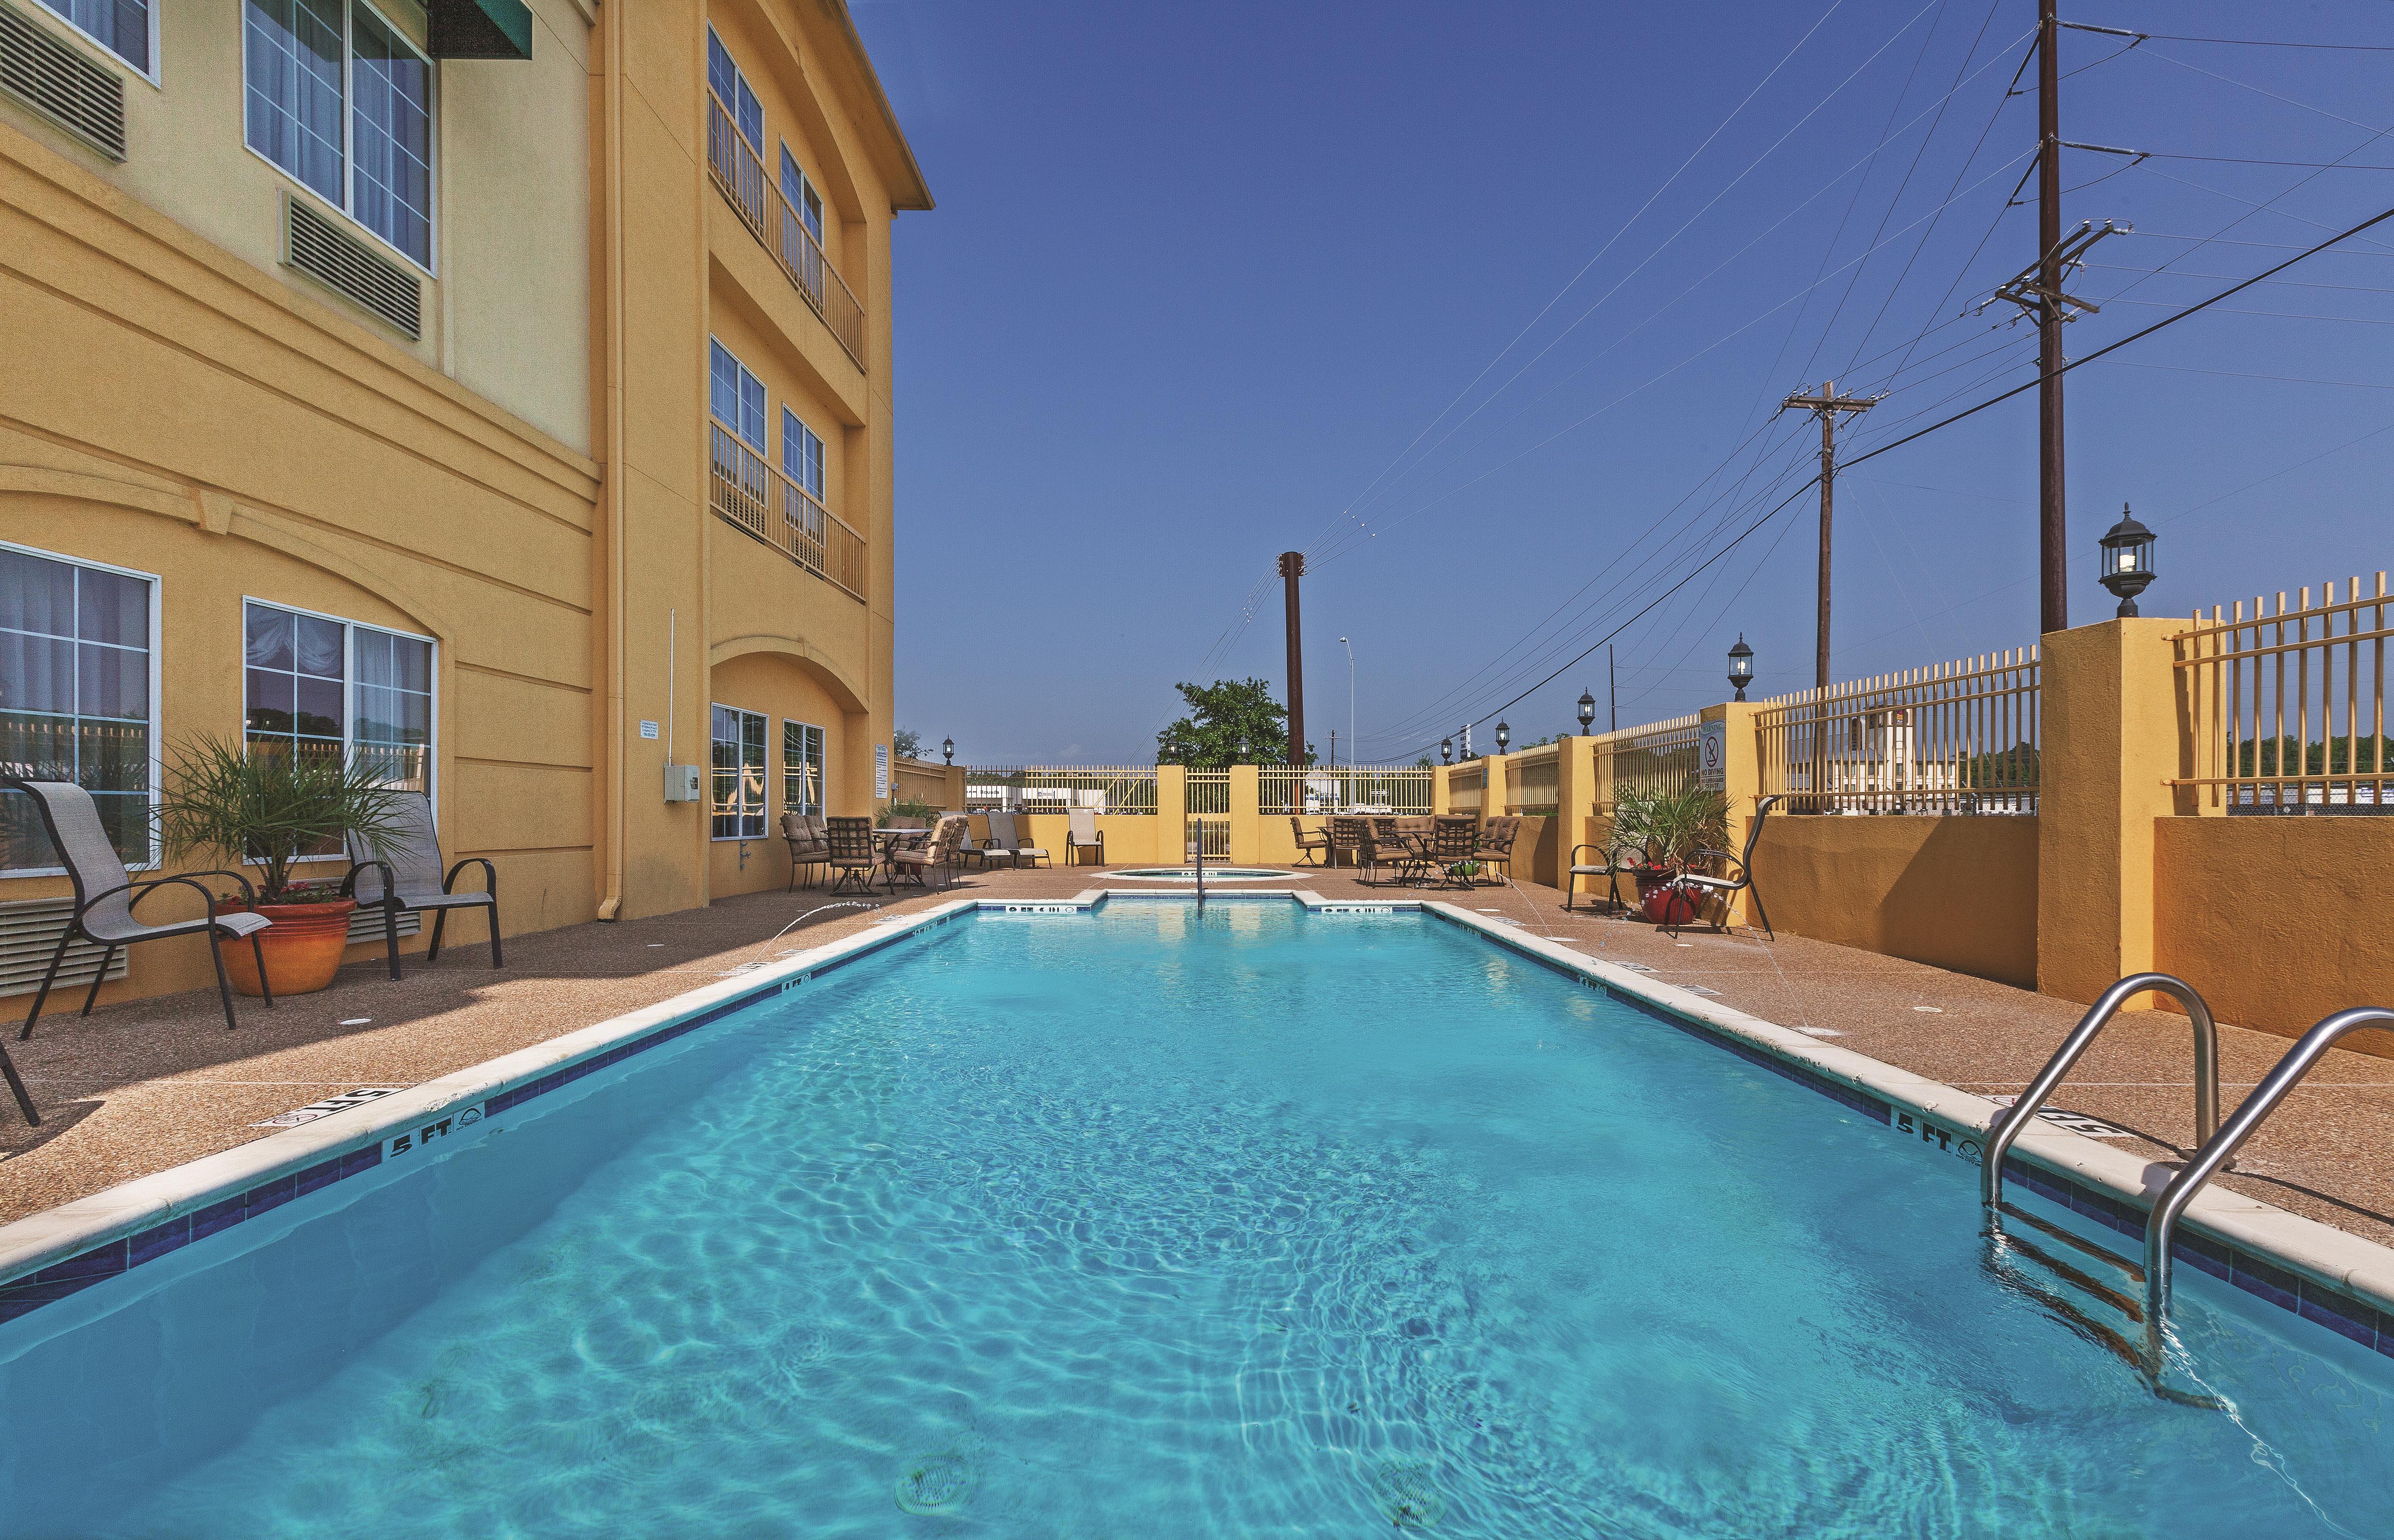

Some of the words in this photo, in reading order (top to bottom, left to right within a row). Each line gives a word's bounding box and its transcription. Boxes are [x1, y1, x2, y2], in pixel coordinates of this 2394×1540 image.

[1708, 767, 1724, 776] DIVING
[1896, 1112, 1914, 1134] 5
[390, 1134, 413, 1158] 5
